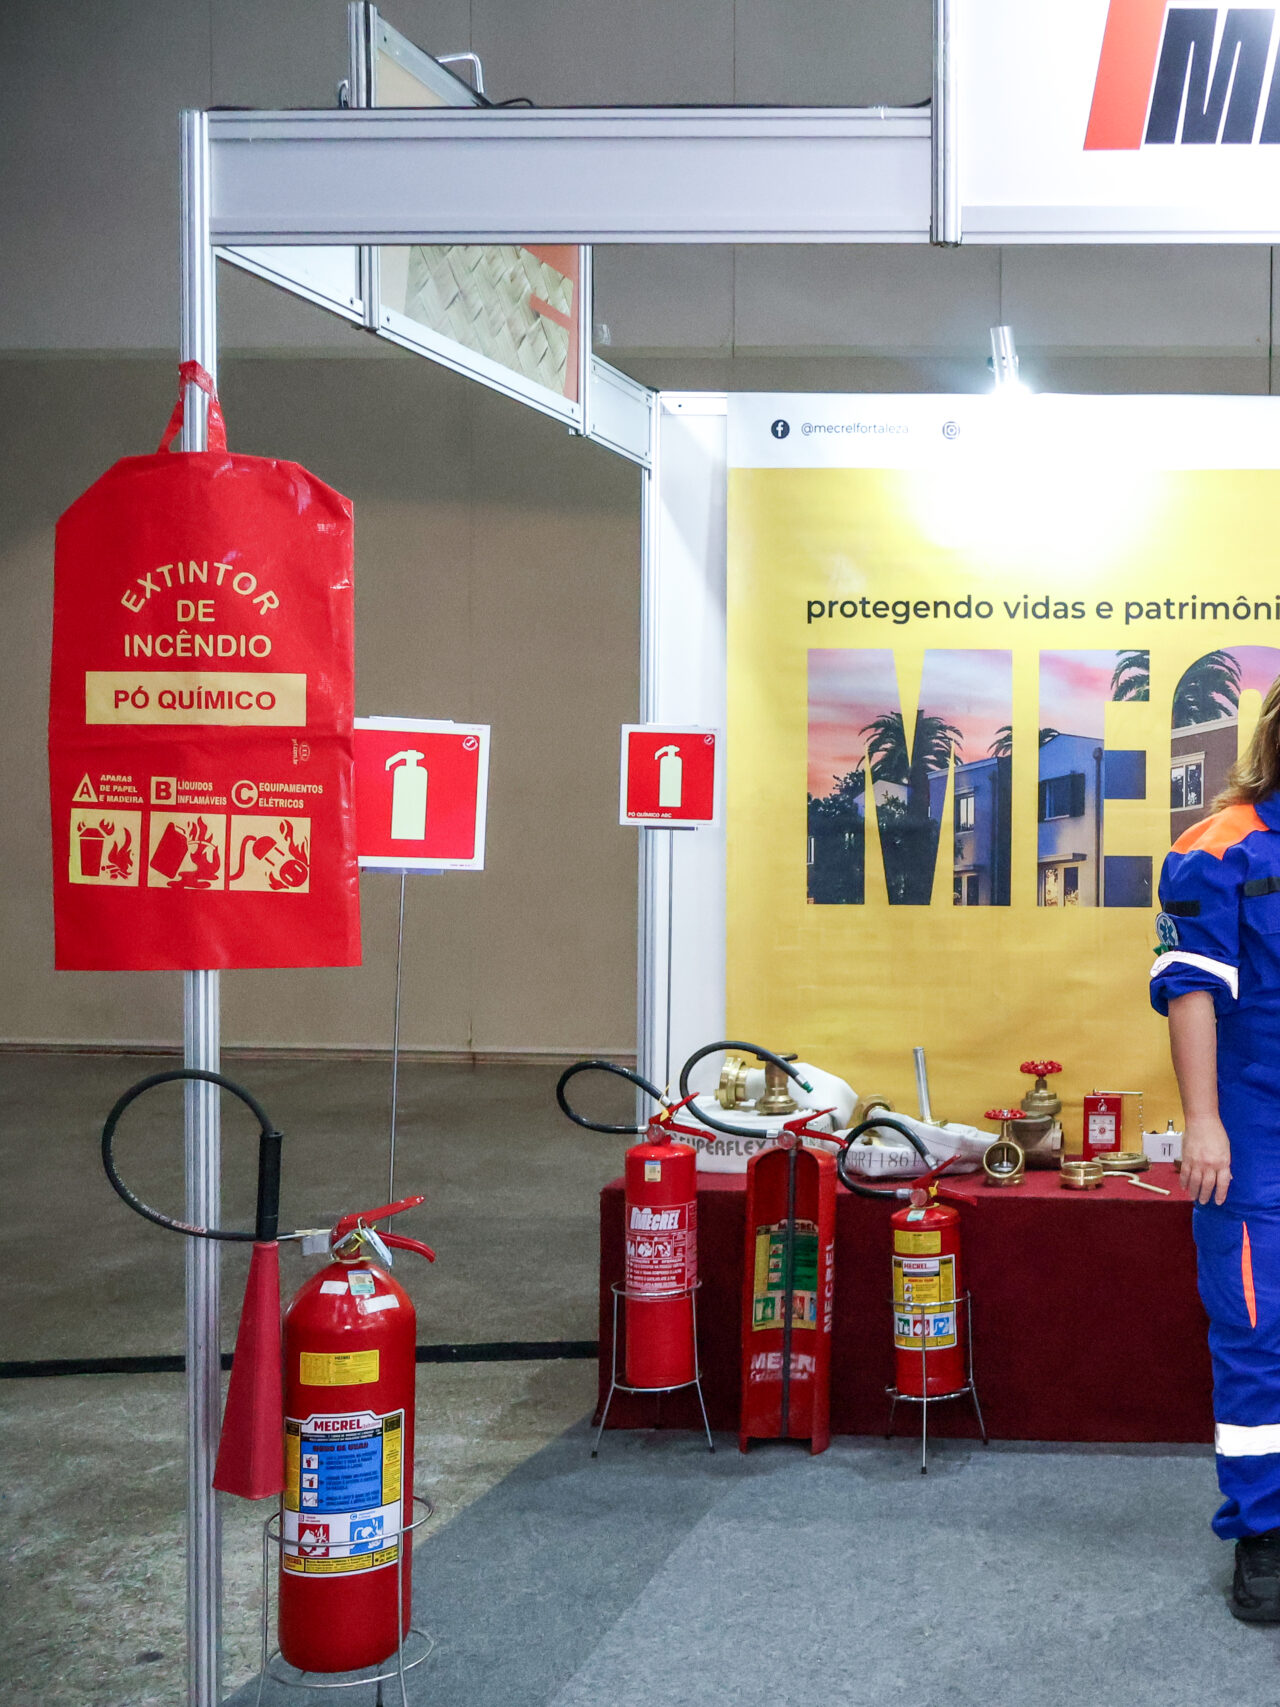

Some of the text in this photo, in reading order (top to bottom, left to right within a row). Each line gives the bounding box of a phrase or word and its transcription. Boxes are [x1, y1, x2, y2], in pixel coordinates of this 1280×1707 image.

[121, 560, 280, 616] EXTINTOR
[177, 600, 215, 622] DE
[807, 594, 994, 625] protegendo
[1003, 594, 1086, 620] vidas
[1095, 601, 1114, 620] e
[124, 629, 272, 658] INCÊNDIO
[114, 686, 276, 710] PÓ QUÍMICO
[100, 774, 132, 783] APARAS
[112, 785, 138, 793] PAPEL
[177, 781, 213, 791] LÍQUIDOS
[259, 782, 323, 794] EQUIPAMENTOS
[106, 795, 144, 804] MADEIRA
[177, 794, 227, 806] INFLAMÁVEIS
[258, 797, 304, 809] ELÉTRICOS
[633, 1211, 680, 1230] MECREL
[314, 1419, 362, 1432] MECREL
